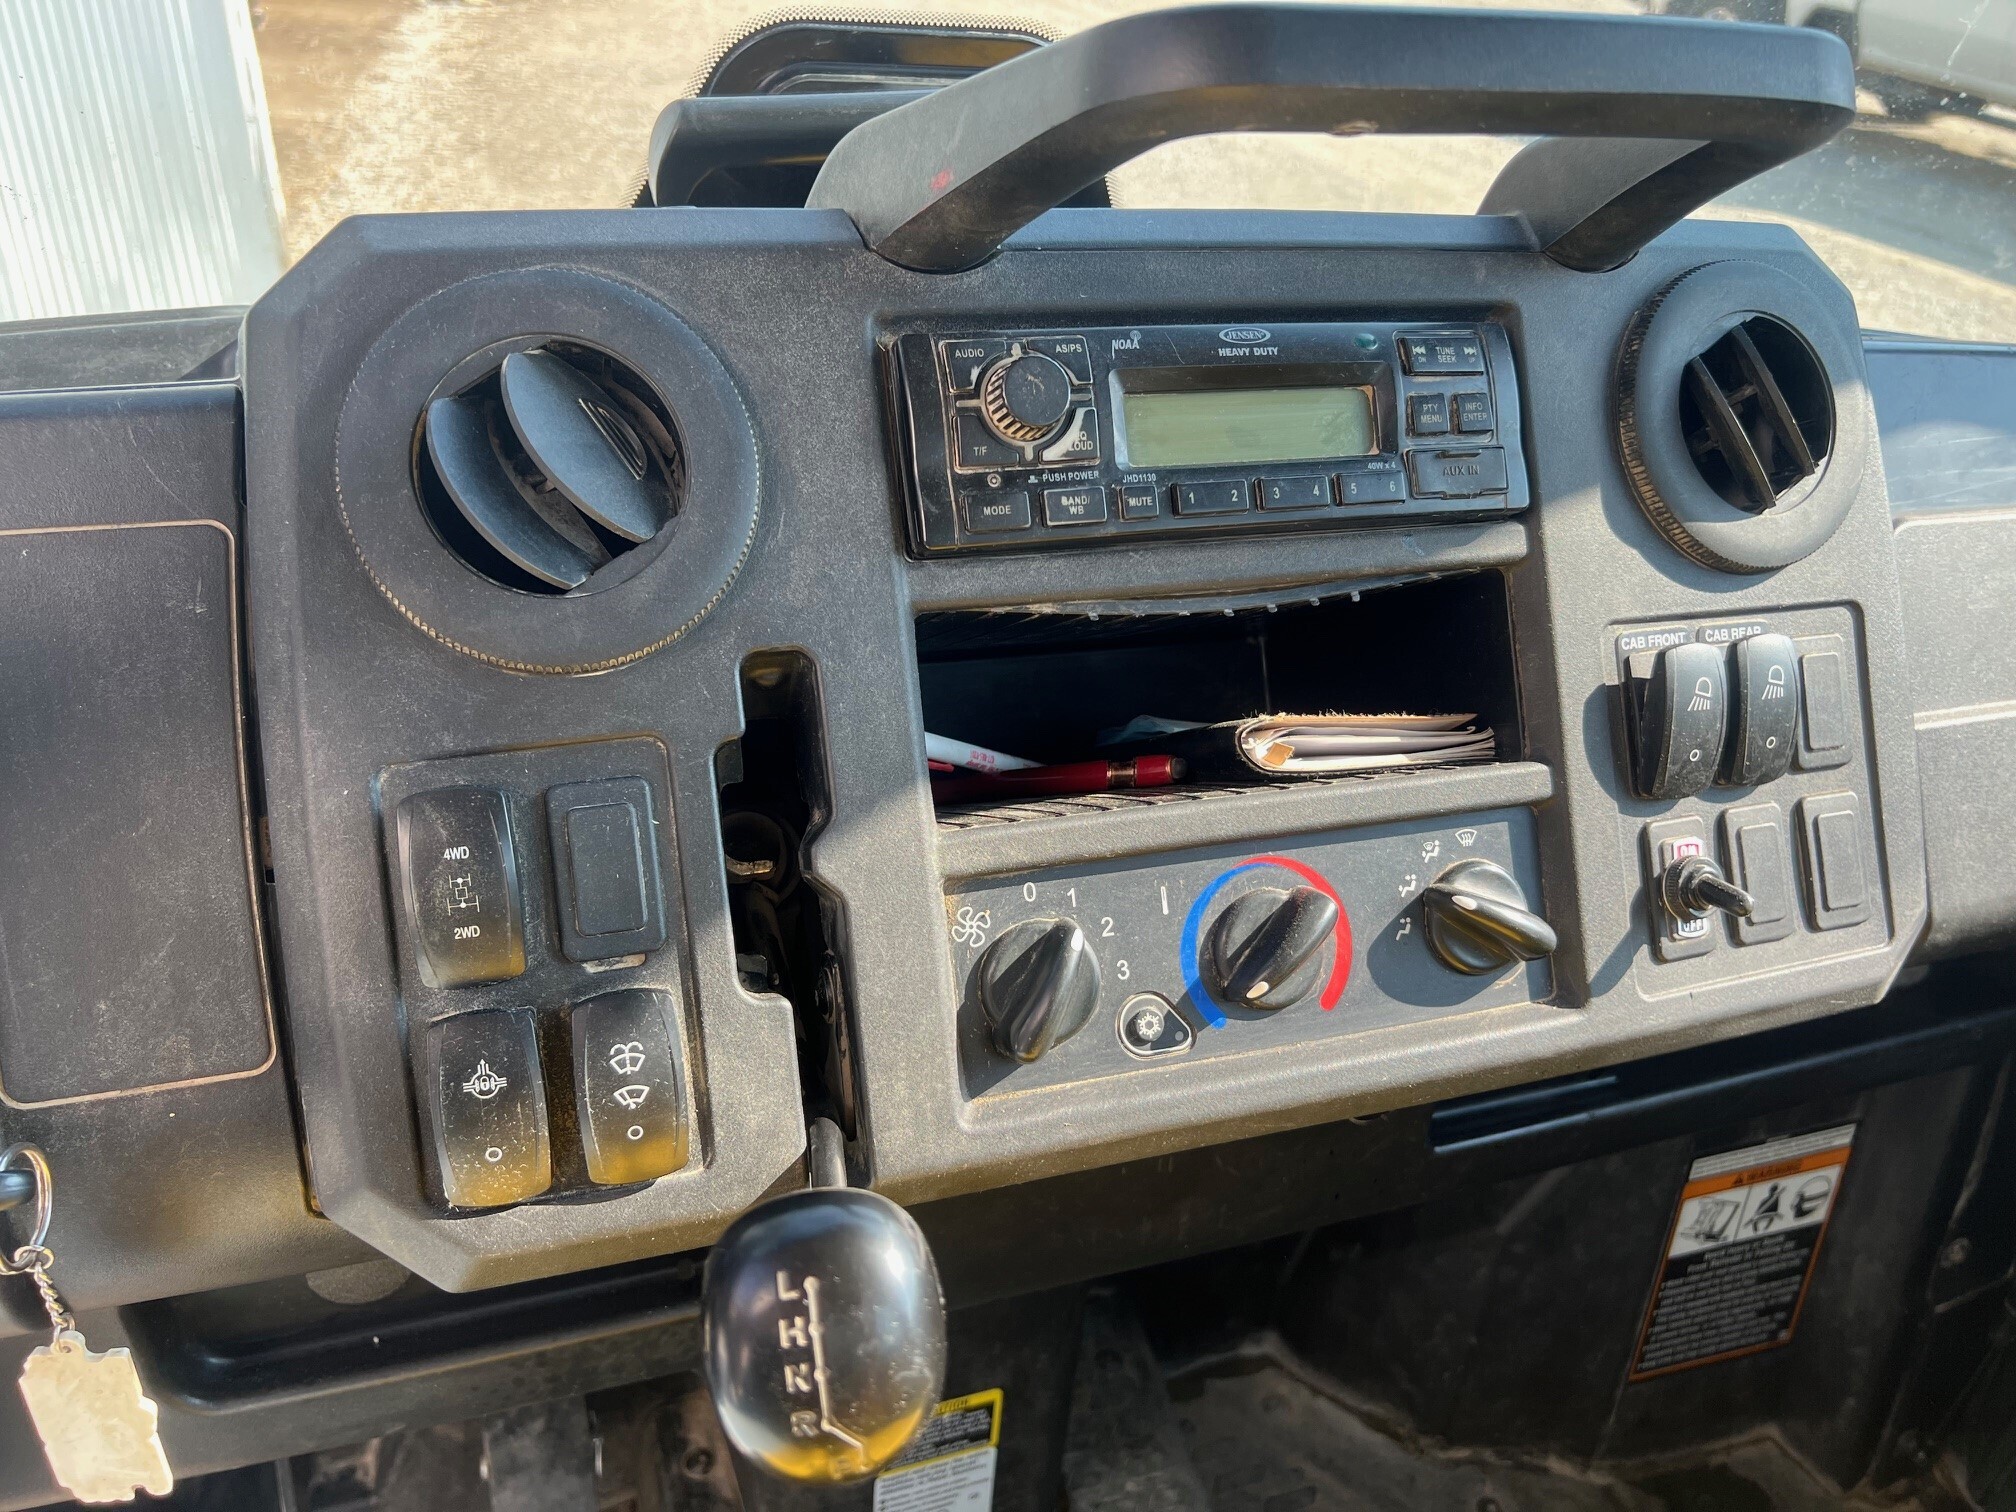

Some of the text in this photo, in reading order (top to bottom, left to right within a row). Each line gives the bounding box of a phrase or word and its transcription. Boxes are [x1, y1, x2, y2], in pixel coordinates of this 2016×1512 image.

[1055, 343, 1083, 354] AS/PS
[1112, 339, 1140, 350] NOAA
[1435, 346, 1456, 355] TUNE
[954, 348, 985, 358] AUDIO
[1218, 346, 1279, 357] HEAVY DUTY
[1437, 354, 1457, 363] SEEK
[1422, 403, 1438, 413] PTY
[1464, 401, 1483, 412] INFO
[1420, 412, 1443, 424] MENU
[1463, 411, 1488, 422] ENTER
[973, 445, 988, 456] T/F
[1367, 461, 1384, 470] 40W
[1390, 461, 1396, 469] 4
[1443, 464, 1480, 477] AUX IN
[1042, 470, 1100, 482] PUSH POWER
[1122, 473, 1157, 484] JHD1130
[1273, 484, 1320, 499] 3 4
[1351, 481, 1396, 495] 5 6
[1060, 495, 1091, 506] BAND/
[1128, 496, 1154, 507] MUTE
[1188, 489, 1238, 504] 1 2
[983, 505, 1012, 516] MODE
[1069, 505, 1085, 515] WB
[1621, 632, 1686, 650] CAB FRONT
[1705, 628, 1729, 642] CAB
[443, 846, 470, 860] 4WD
[1023, 882, 1078, 908] 0 1
[454, 925, 481, 940] 2WD
[1100, 917, 1115, 938] 2
[1117, 960, 1131, 981] 3
[776, 1270, 800, 1300] L
[778, 1316, 808, 1349] H
[784, 1363, 812, 1394] N
[790, 1411, 819, 1437] R
